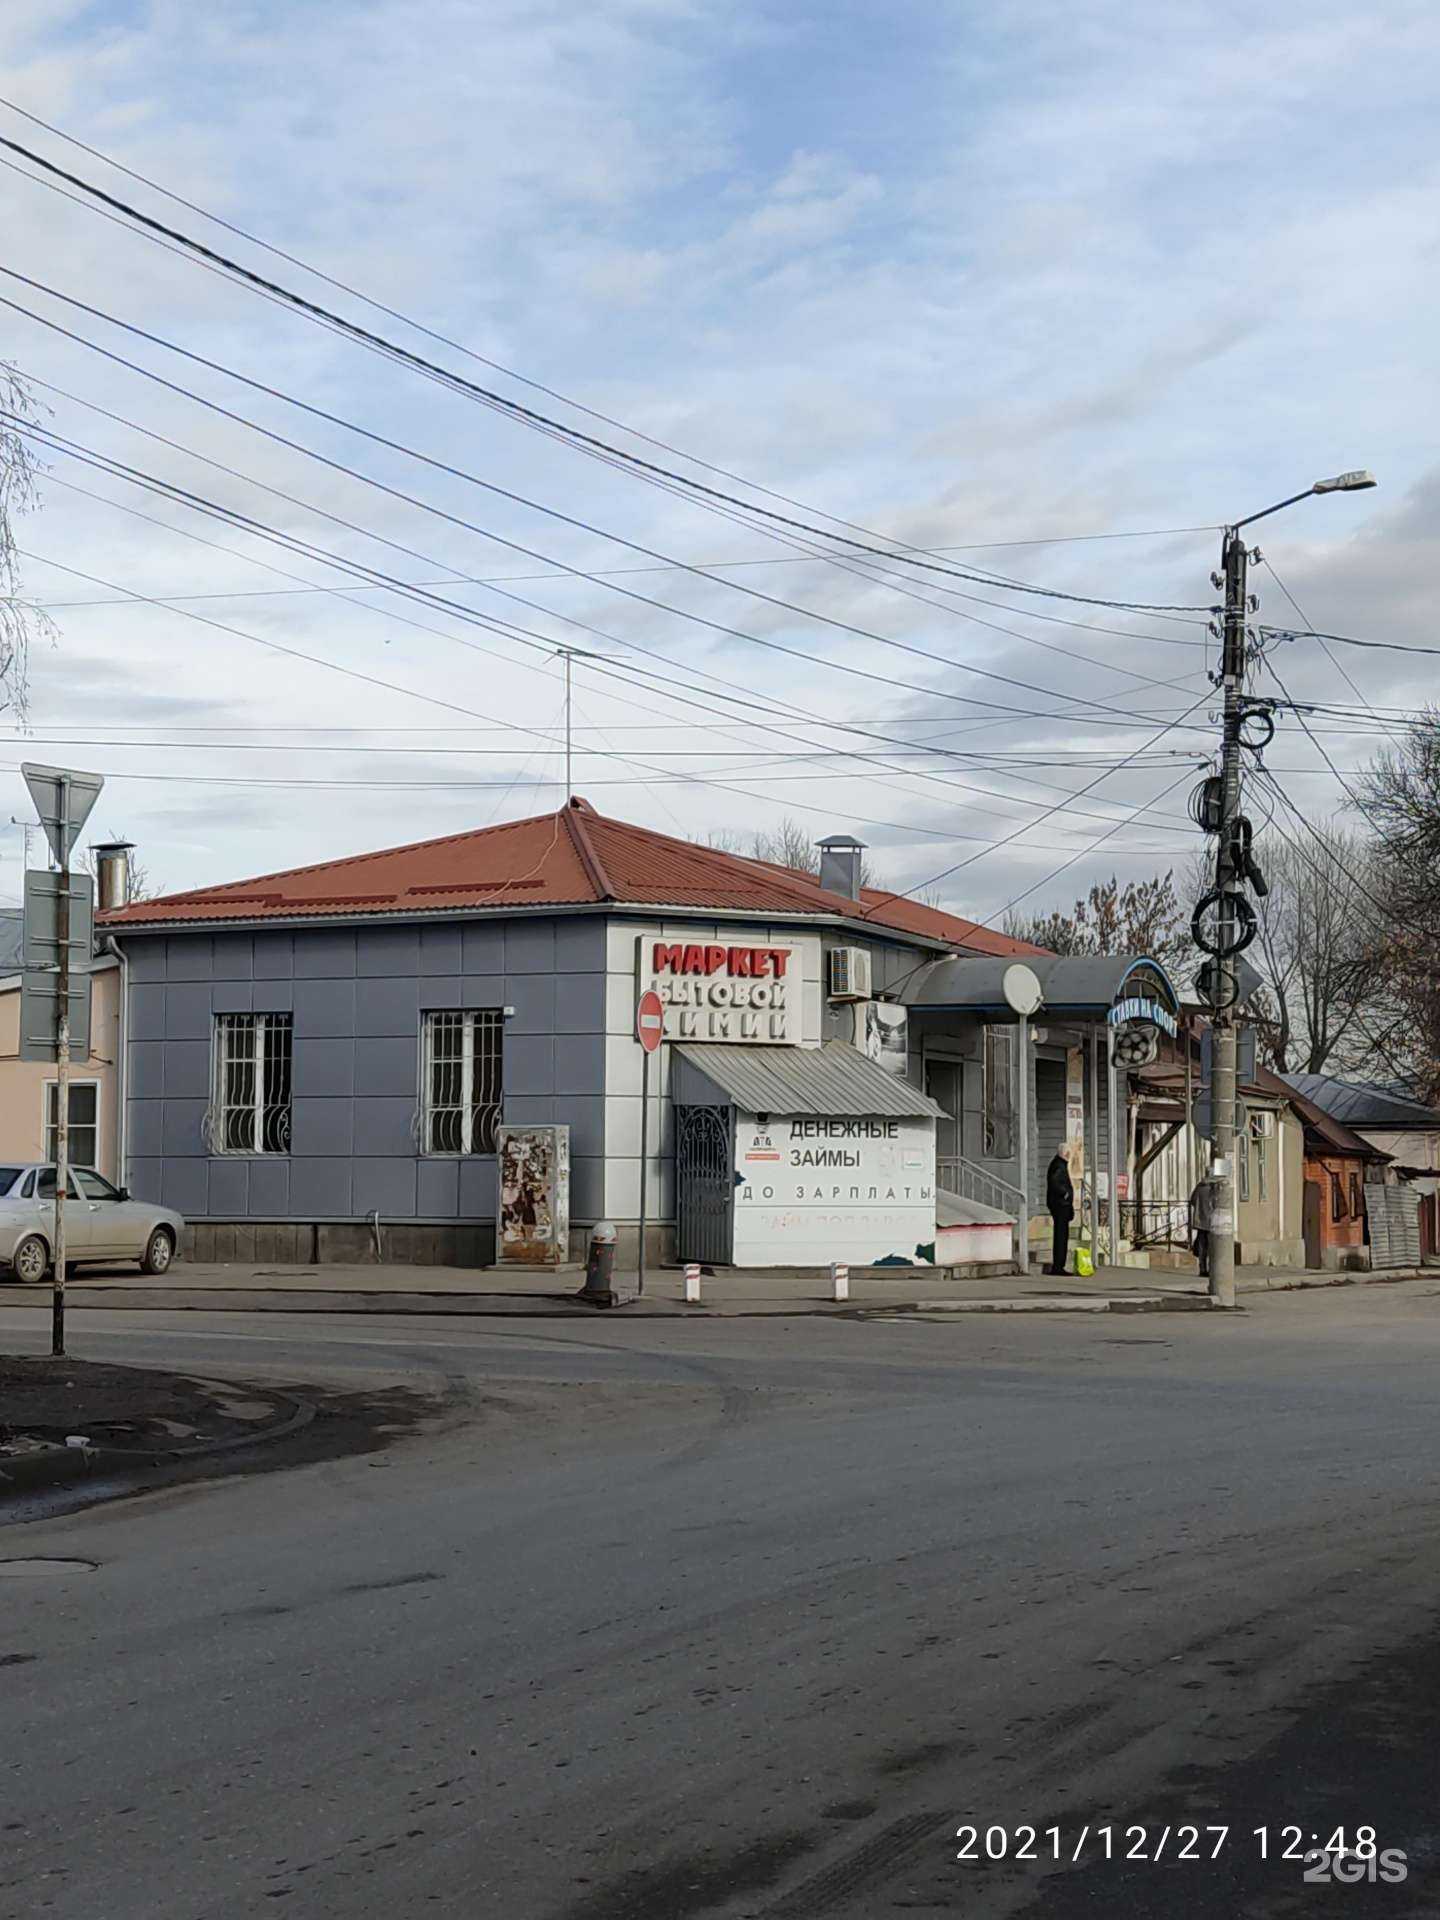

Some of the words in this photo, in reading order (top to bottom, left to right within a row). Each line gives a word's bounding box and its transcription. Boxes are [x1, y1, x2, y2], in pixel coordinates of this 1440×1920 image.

[653, 943, 791, 978] МАРКЕТ
[652, 980, 788, 1010] БЫТОВОЙ
[790, 1120, 899, 1140] ДЕНЕЖНЫЕ
[790, 1146, 860, 1167] ЗАЙМЫ
[743, 1187, 774, 1200] ДО
[796, 1187, 931, 1199] ЗАРПЛАТЫ
